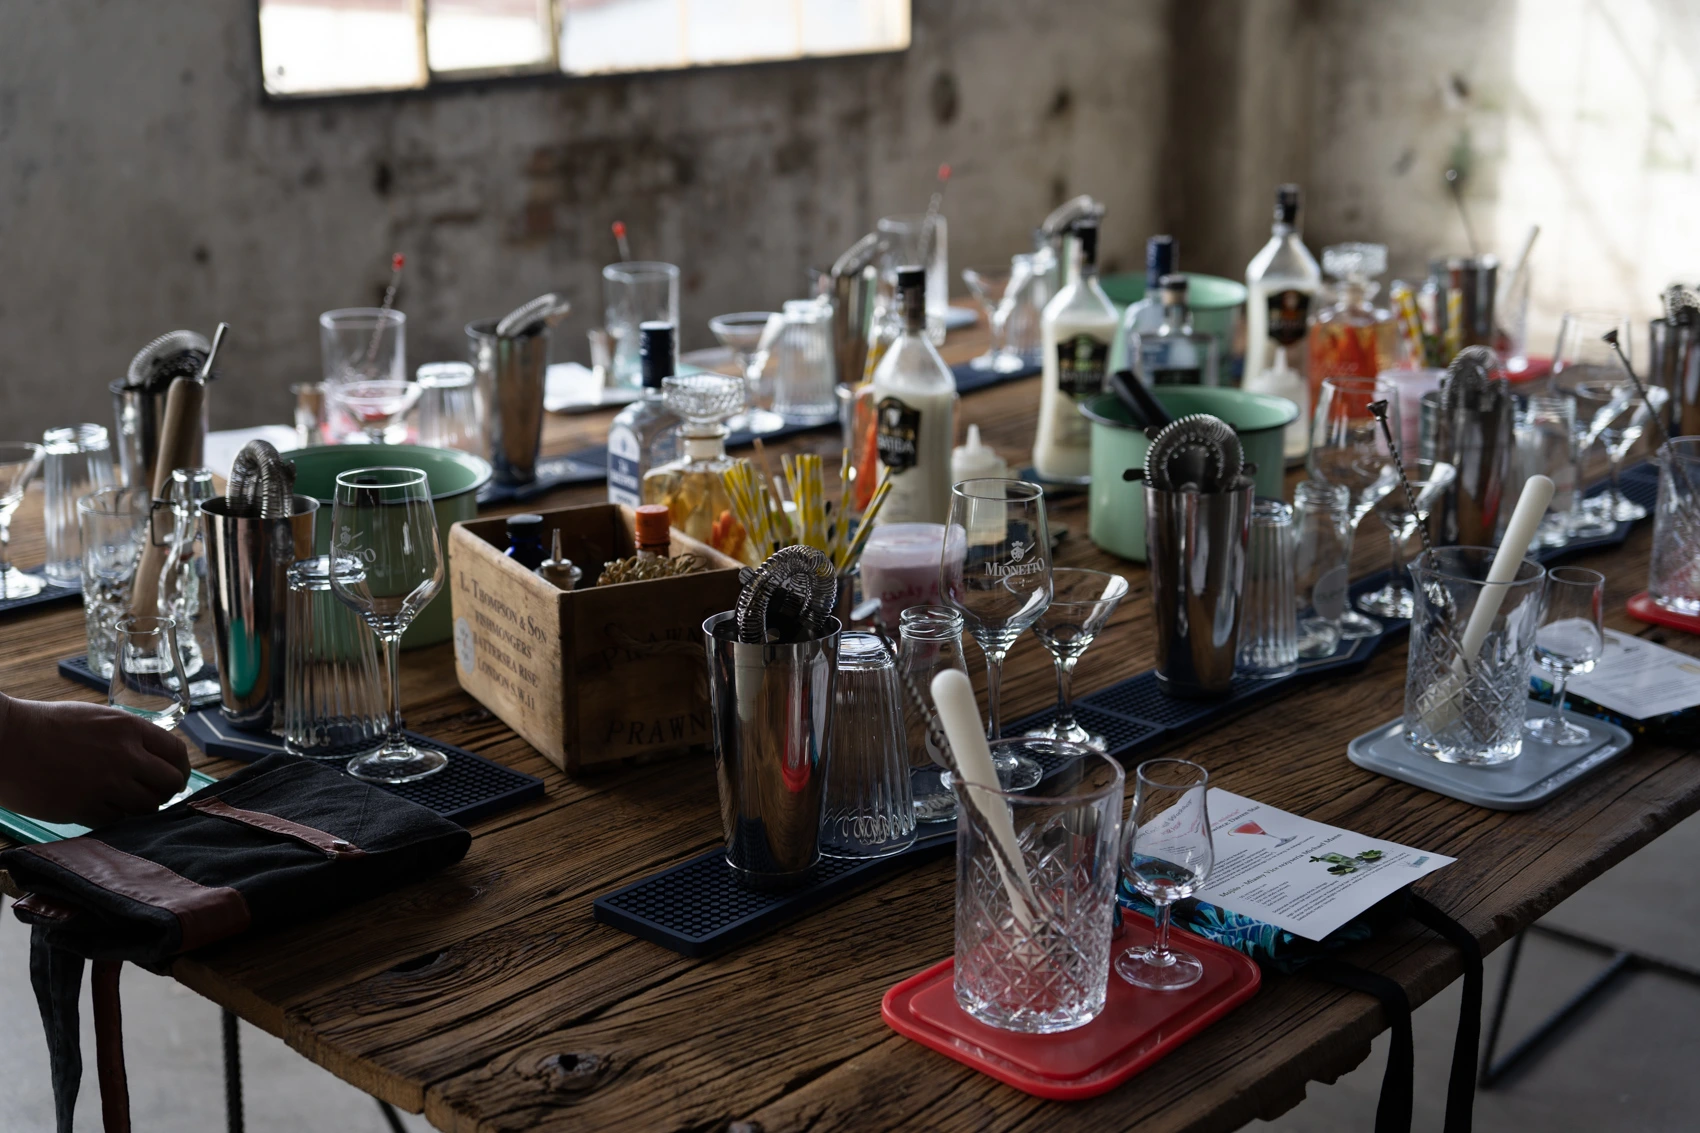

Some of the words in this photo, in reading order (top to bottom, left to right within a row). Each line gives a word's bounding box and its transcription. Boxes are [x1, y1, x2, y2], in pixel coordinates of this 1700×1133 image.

[984, 557, 1045, 577] MIONETTO
[519, 616, 527, 632] &
[527, 615, 548, 644] SON
[473, 631, 518, 675] BATTERSEA
[477, 657, 510, 690] LONDON
